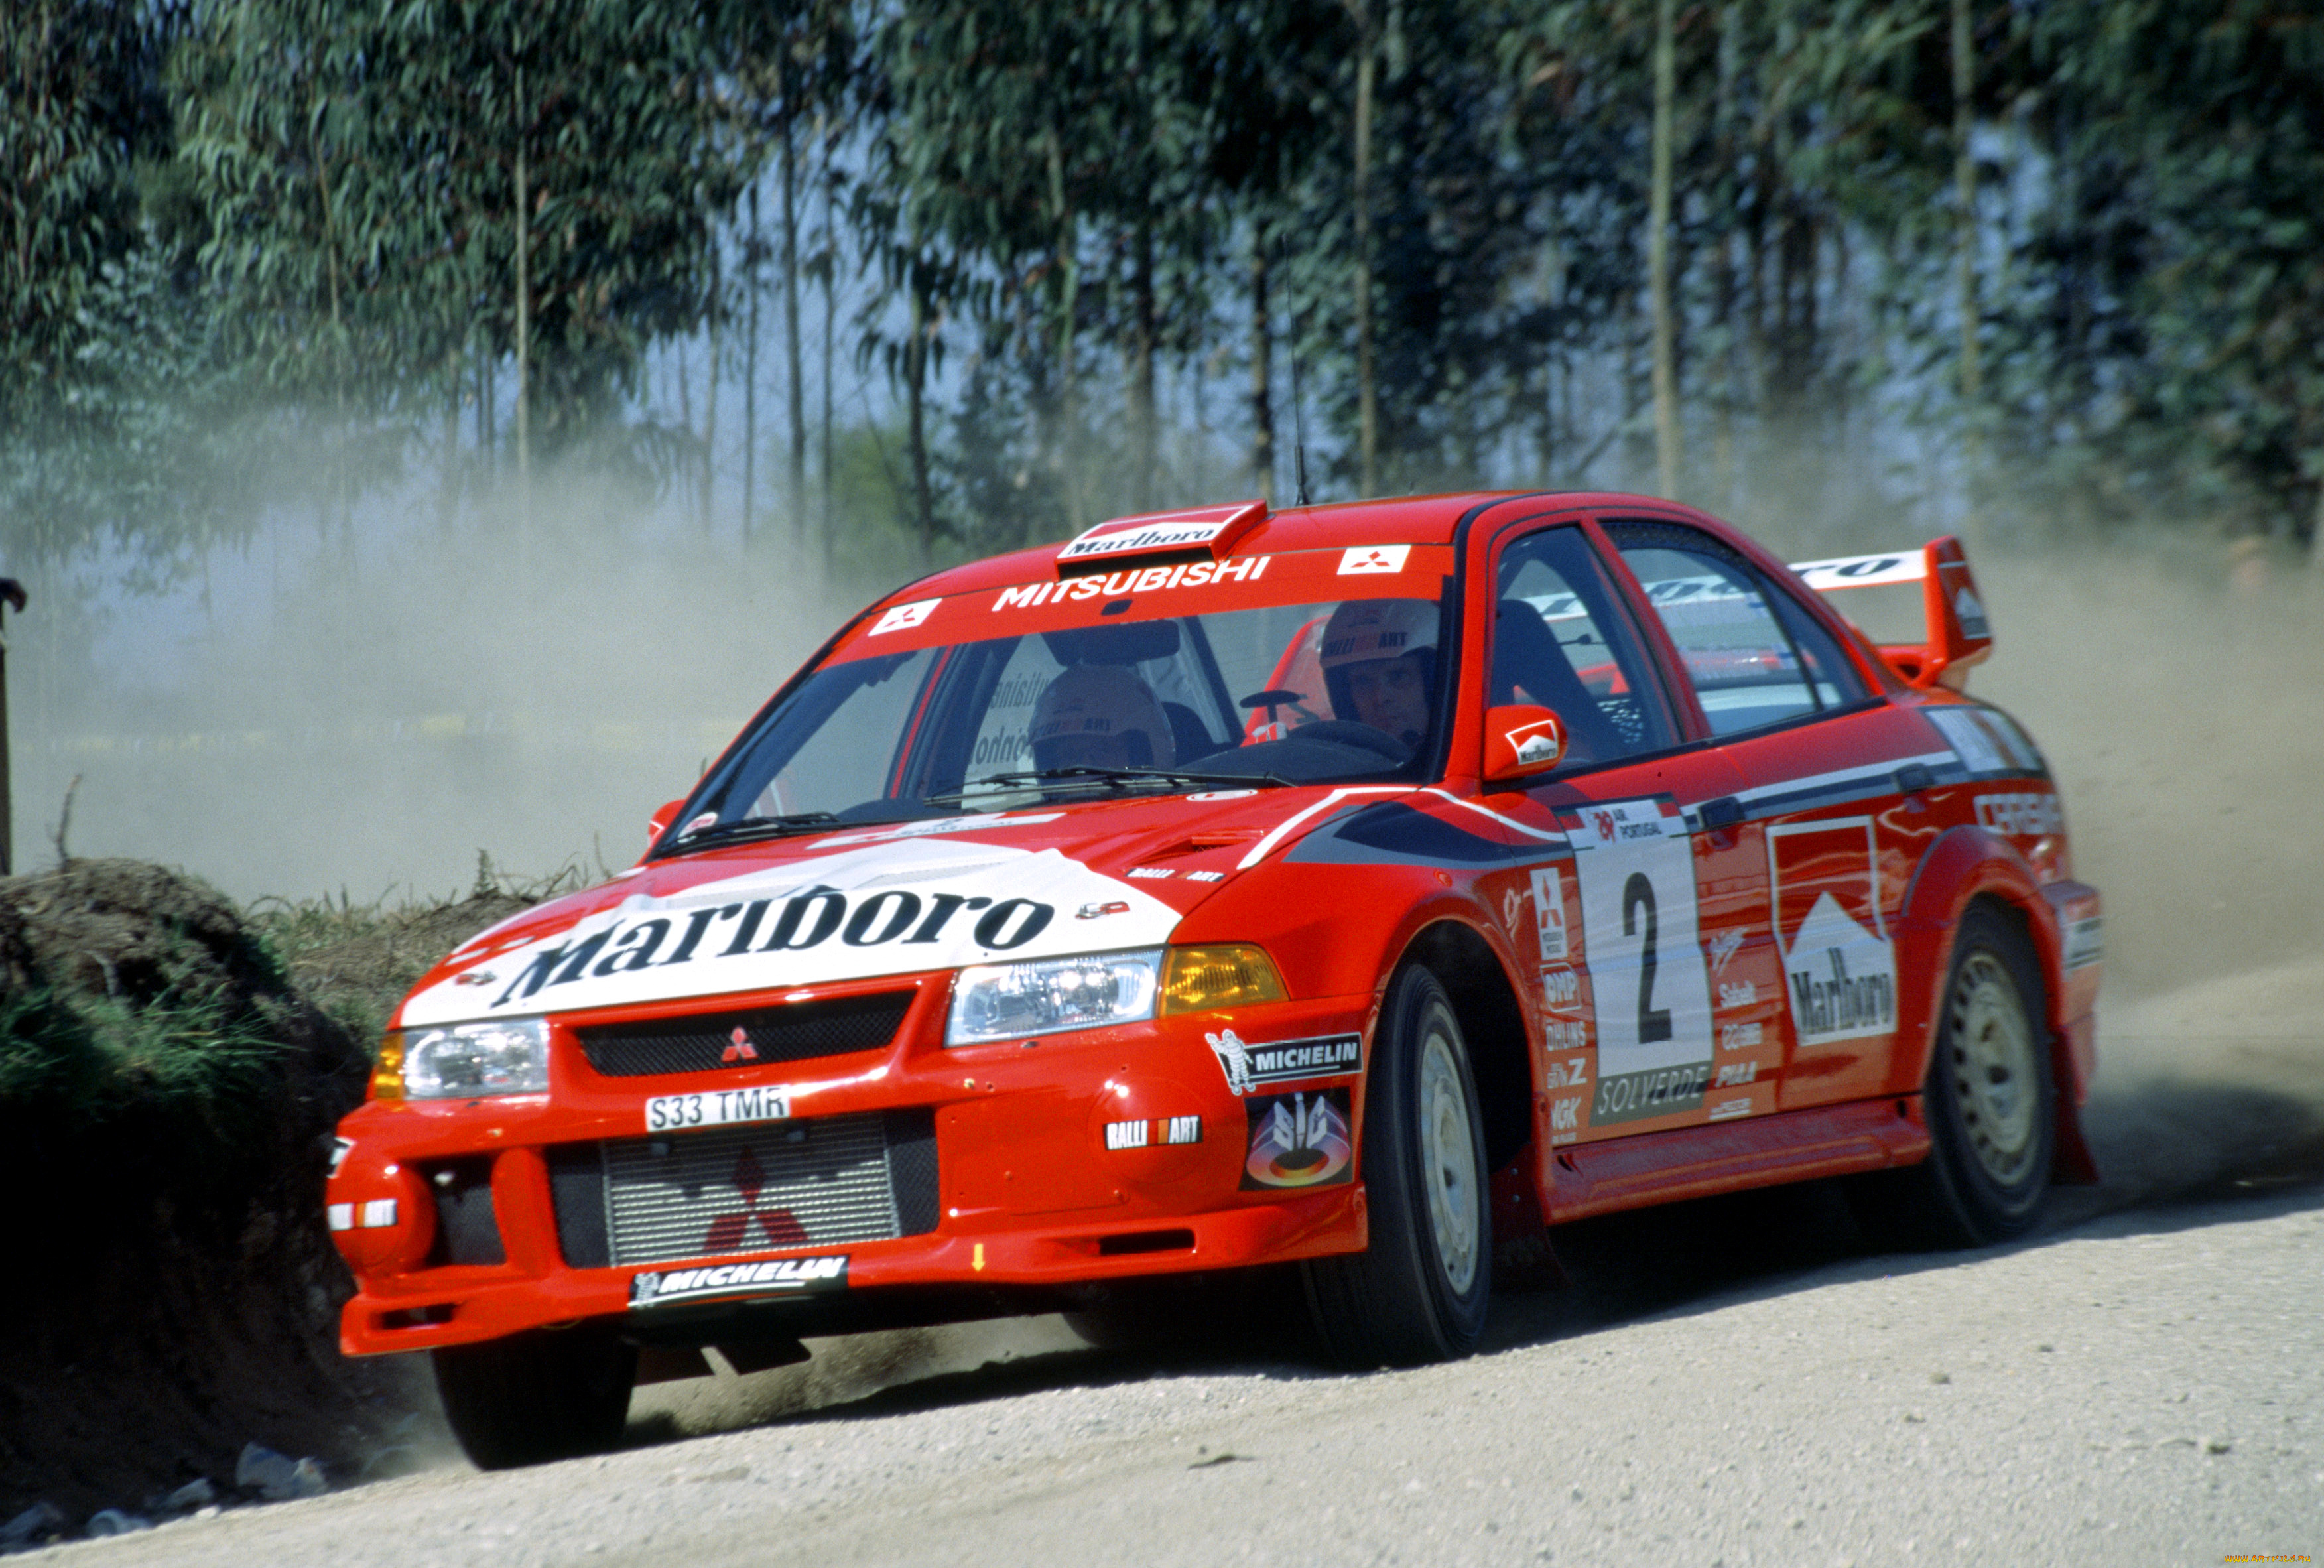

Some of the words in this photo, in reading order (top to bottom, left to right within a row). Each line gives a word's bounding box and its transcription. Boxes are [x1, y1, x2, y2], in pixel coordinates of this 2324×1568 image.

[1067, 529, 1215, 555] Marlboro
[992, 556, 1271, 612] MITSUBISHI
[490, 884, 1055, 1009] Marlboro
[1622, 872, 1672, 1044] 2
[1545, 971, 1577, 1003] OMP
[1256, 1042, 1358, 1071] MICHELIN
[651, 1095, 703, 1128] S33
[716, 1087, 785, 1121] TMR
[1598, 1065, 1709, 1115] SOLVERDE
[1107, 1119, 1148, 1150] RALLI
[1168, 1115, 1199, 1144] ART
[658, 1258, 847, 1293] MICHELIN
